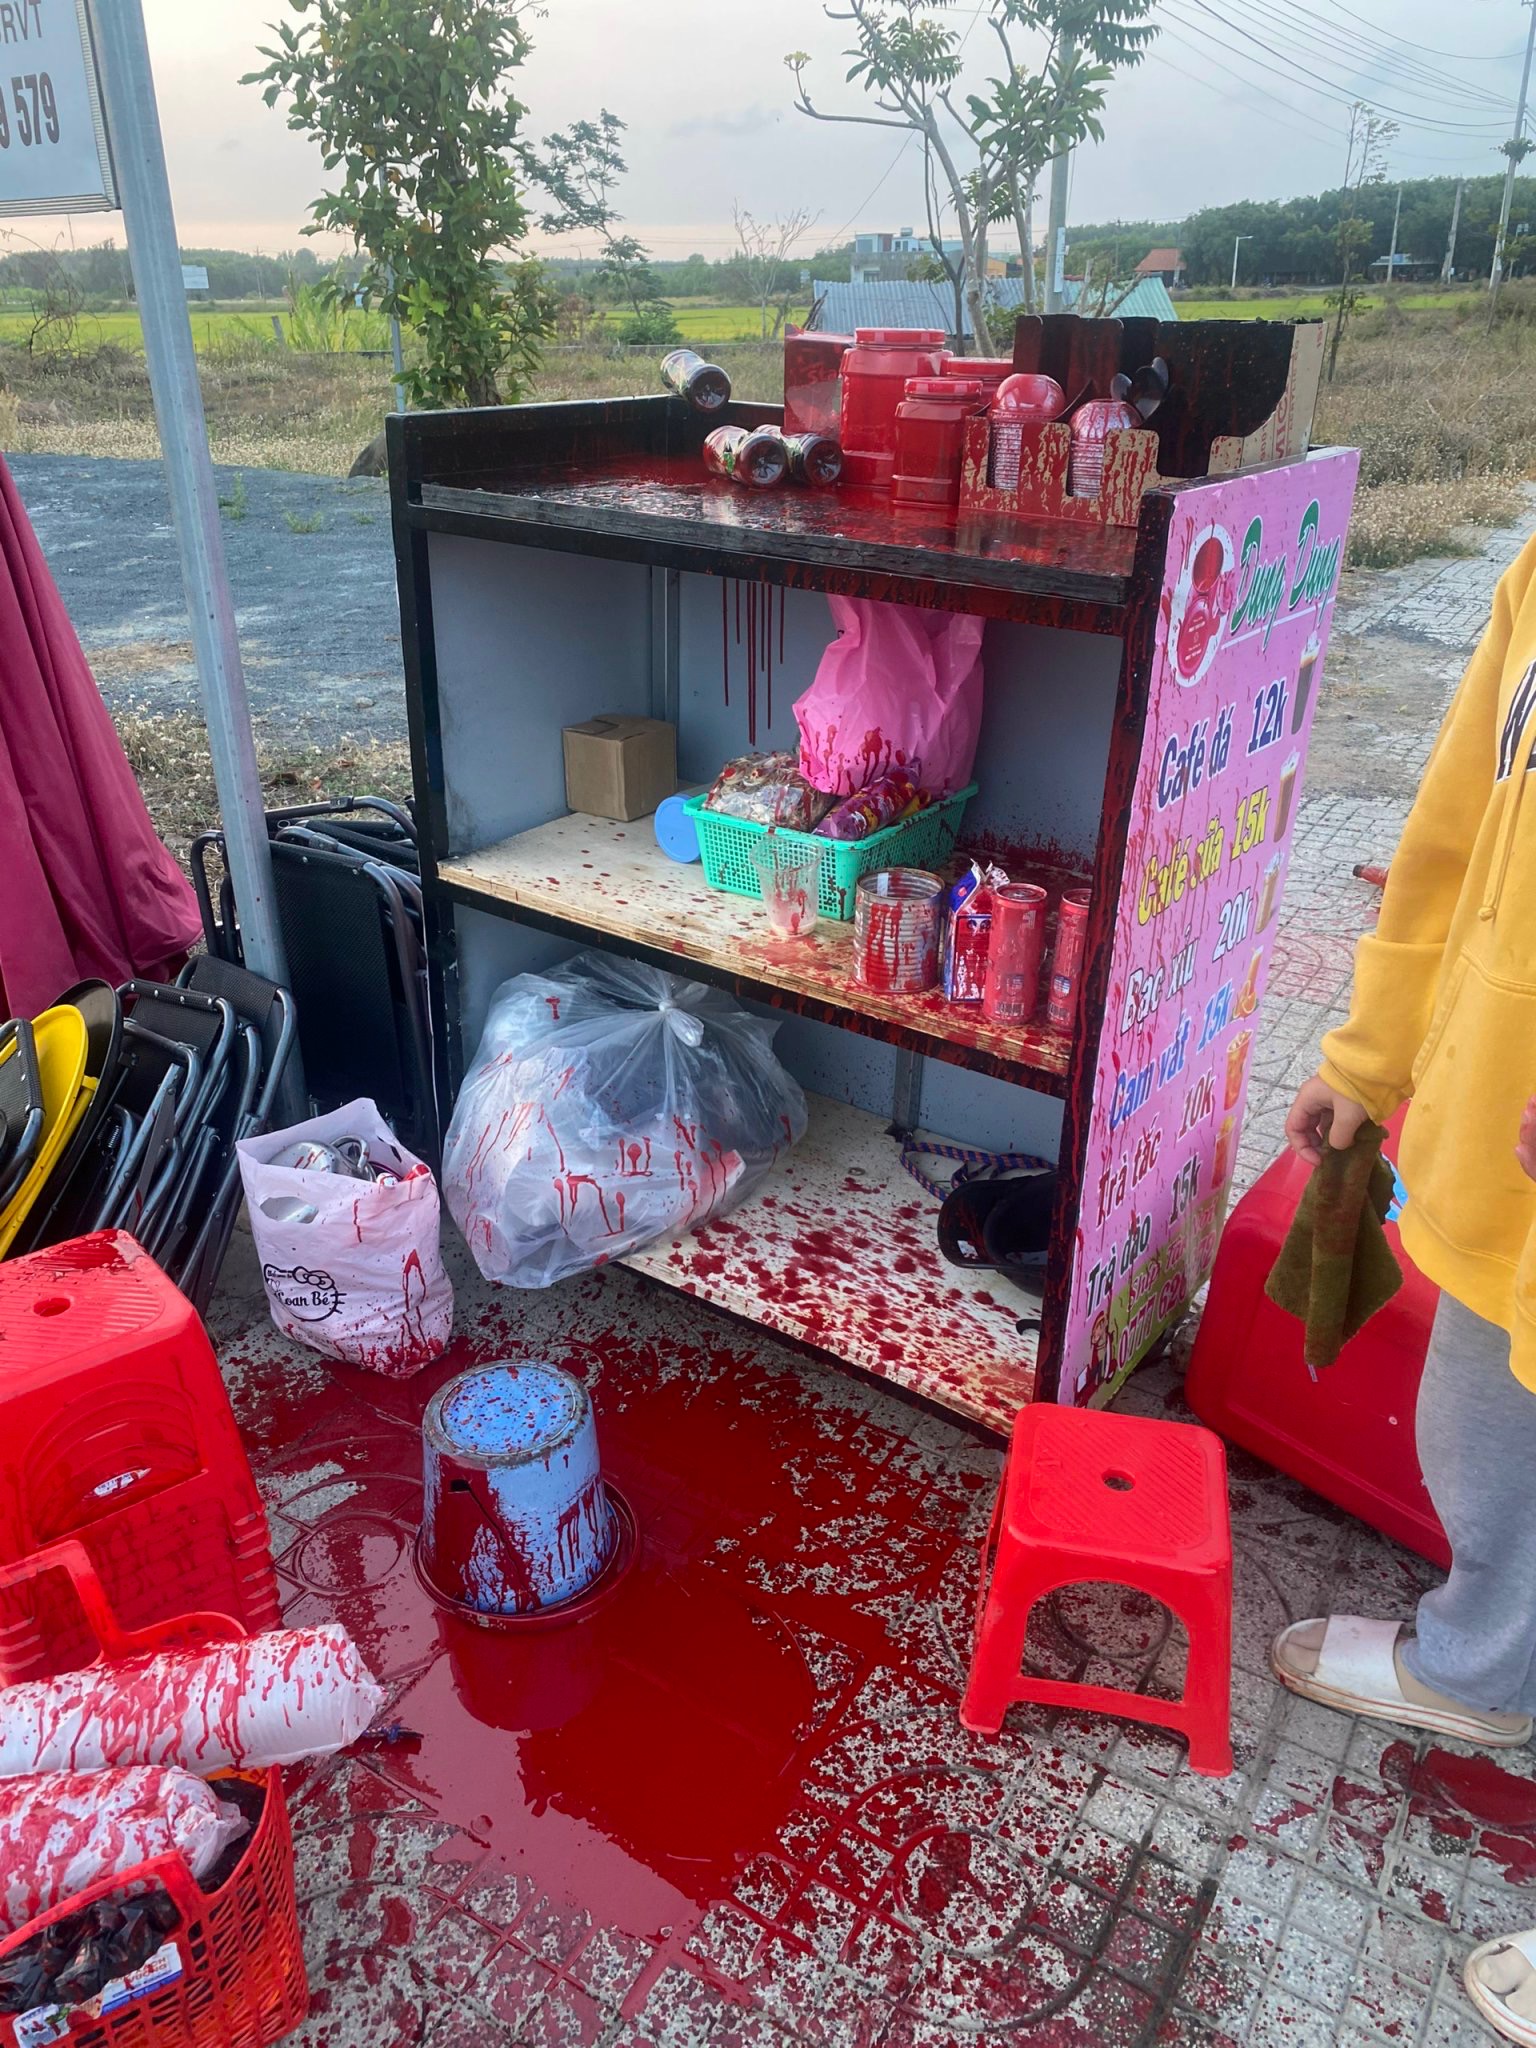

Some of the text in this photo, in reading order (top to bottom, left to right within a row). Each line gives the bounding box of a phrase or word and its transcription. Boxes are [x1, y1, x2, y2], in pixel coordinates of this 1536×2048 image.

[0, 0, 43, 45] RVT
[11, 72, 60, 147] 579
[1157, 677, 1289, 811] Café đá 12k
[1138, 835, 1193, 926] Café
[1230, 785, 1271, 862] 15k
[1121, 967, 1165, 1037] Bạc
[1212, 886, 1253, 963] 20k
[1108, 1059, 1156, 1134] Cam
[1196, 978, 1235, 1055] 15k
[1096, 1151, 1129, 1231] Trà
[1176, 1067, 1217, 1142] 10k
[311, 1290, 330, 1306] Bé
[1086, 1242, 1117, 1321] Trà
[1168, 1153, 1202, 1229] 15k
